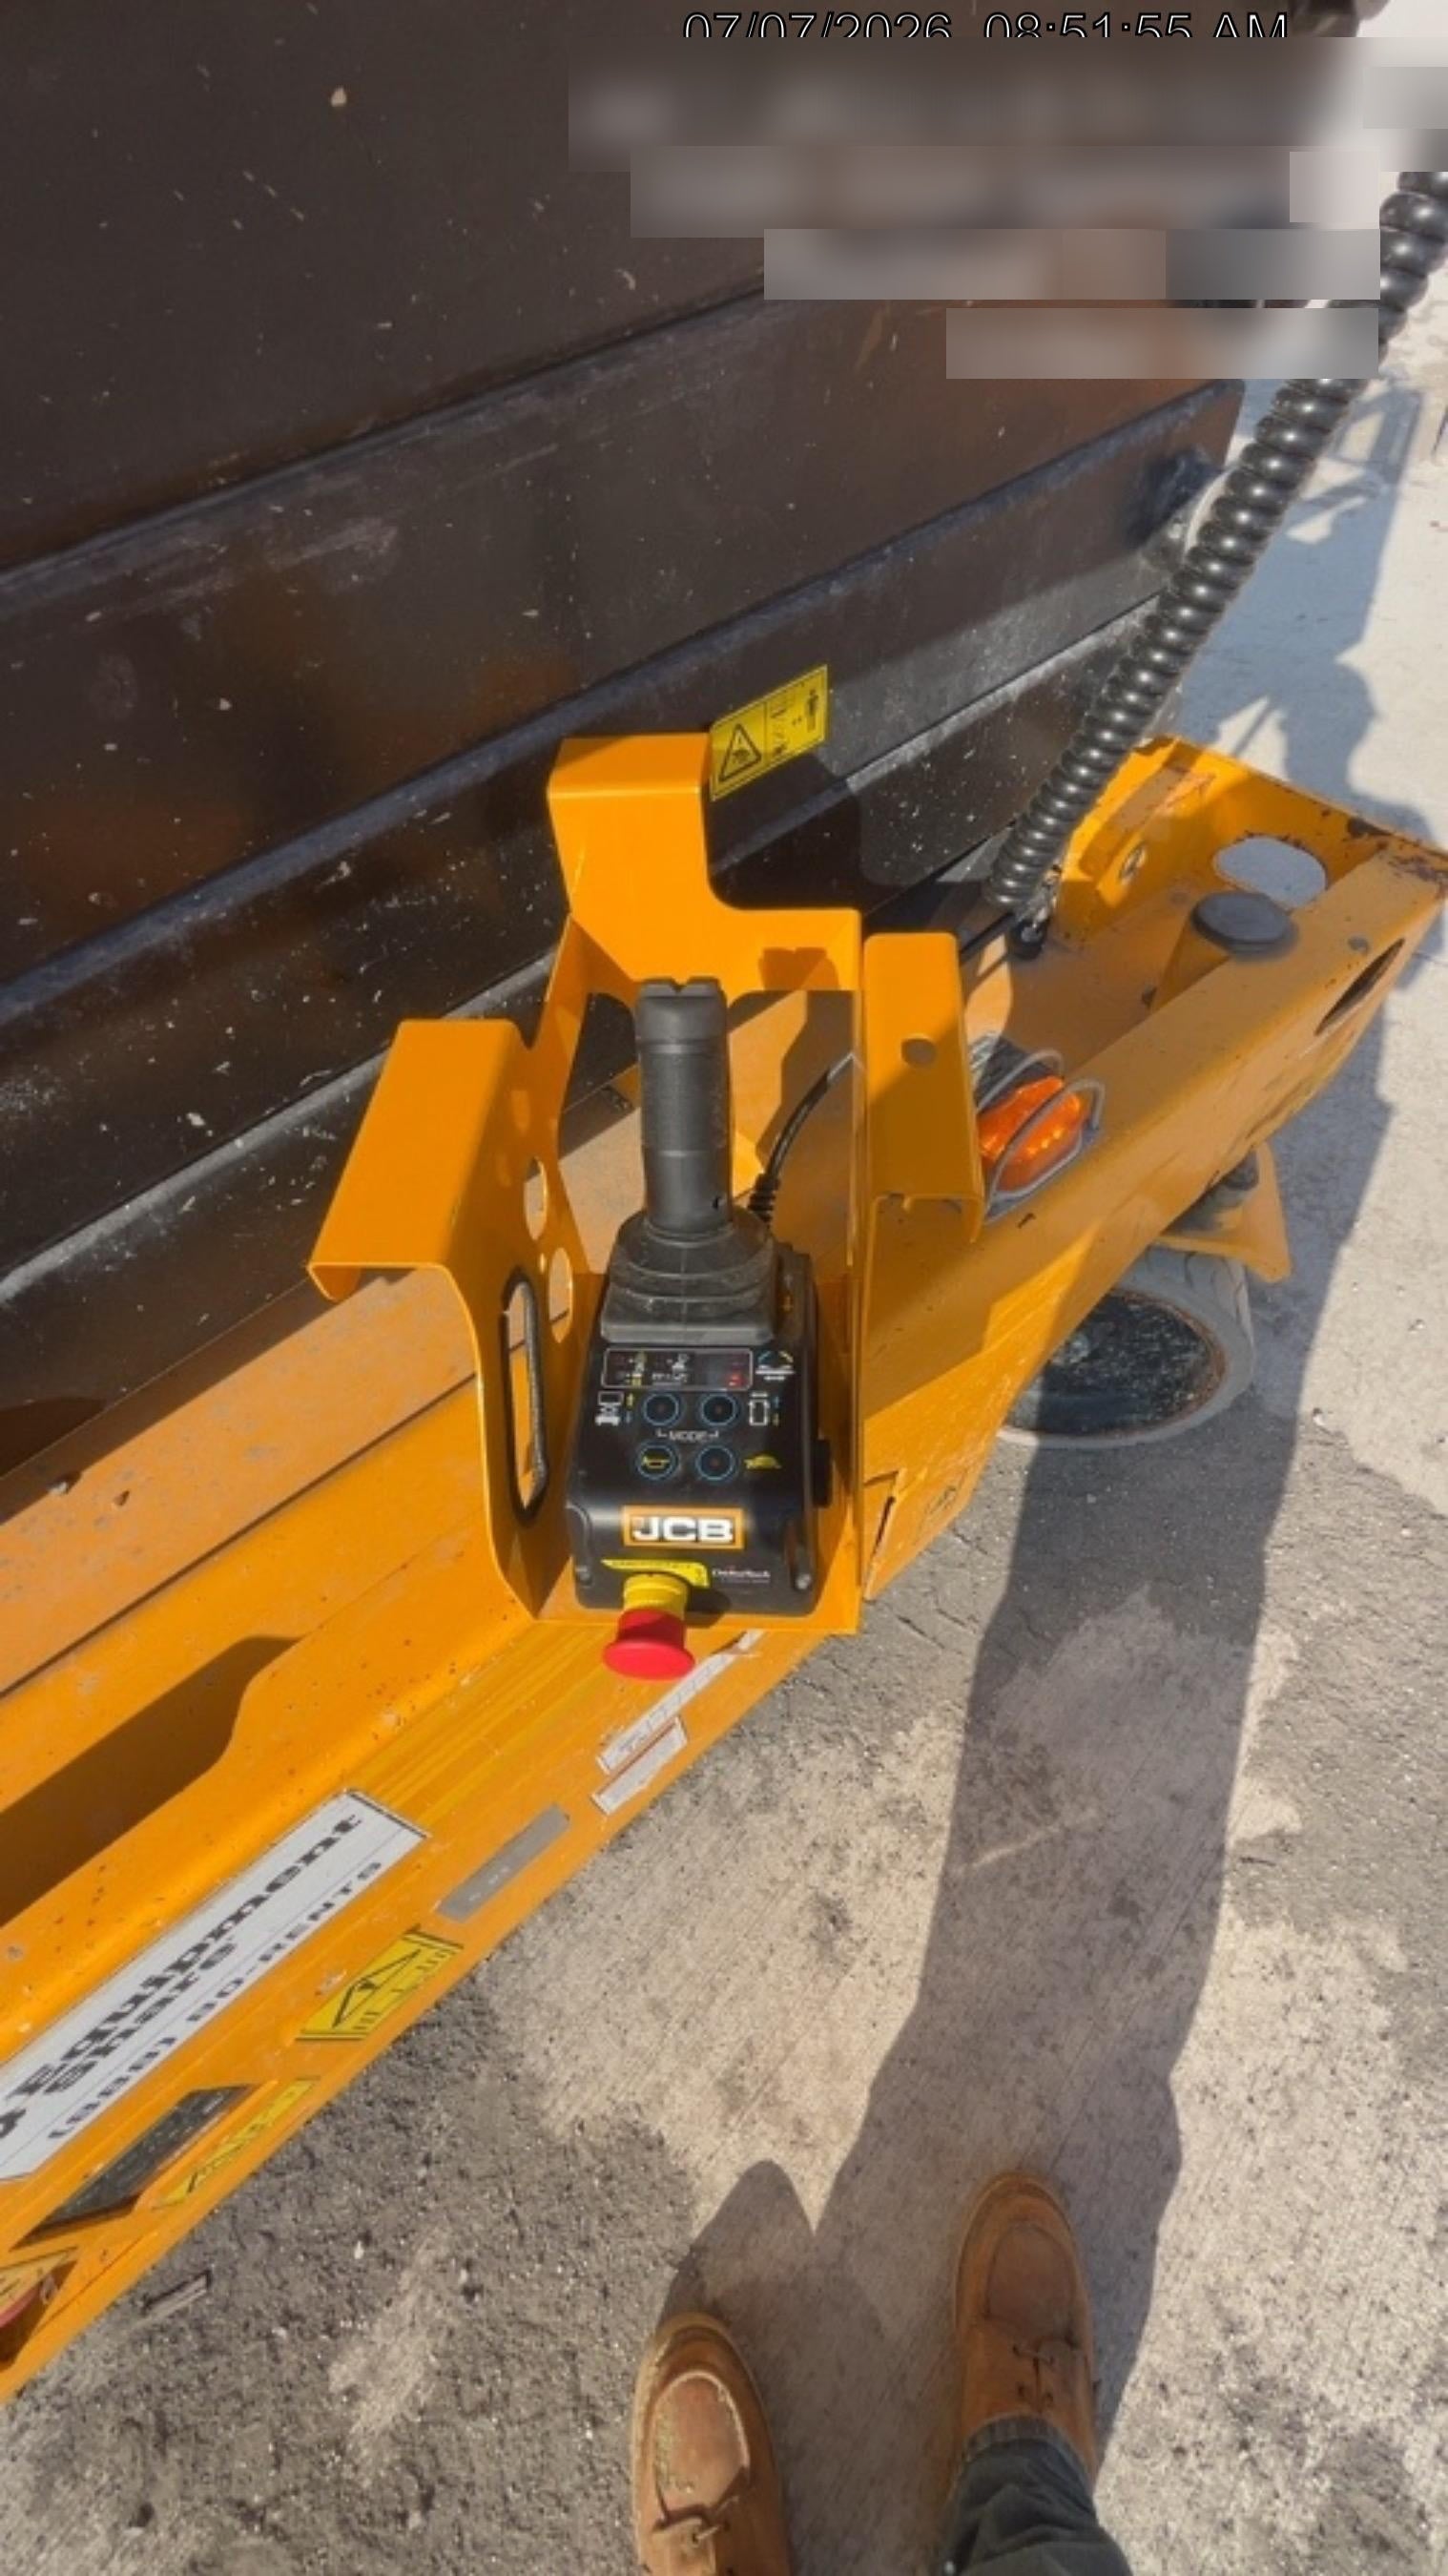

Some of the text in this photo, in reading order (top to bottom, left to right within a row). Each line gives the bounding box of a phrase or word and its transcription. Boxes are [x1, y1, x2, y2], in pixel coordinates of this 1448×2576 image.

[632, 1515, 734, 1543] JCB
[13, 1814, 362, 2095] Equipment
[43, 1942, 237, 2095] Share
